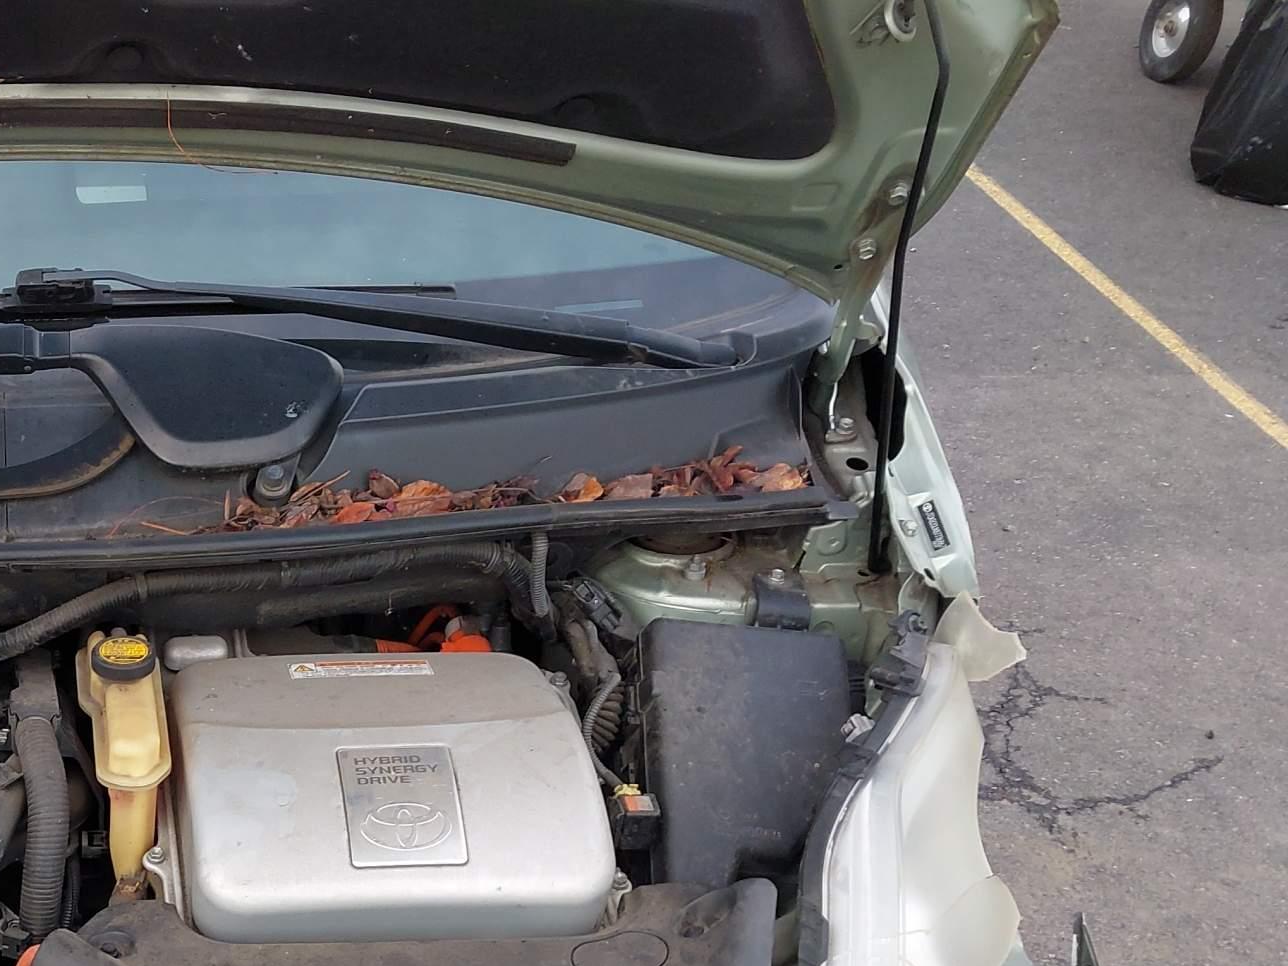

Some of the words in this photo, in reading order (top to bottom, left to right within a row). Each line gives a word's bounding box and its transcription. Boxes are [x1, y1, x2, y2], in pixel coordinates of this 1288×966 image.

[353, 755, 421, 766] HYBRID
[355, 764, 438, 776] SYNERGY
[357, 775, 412, 785] DRIVE
